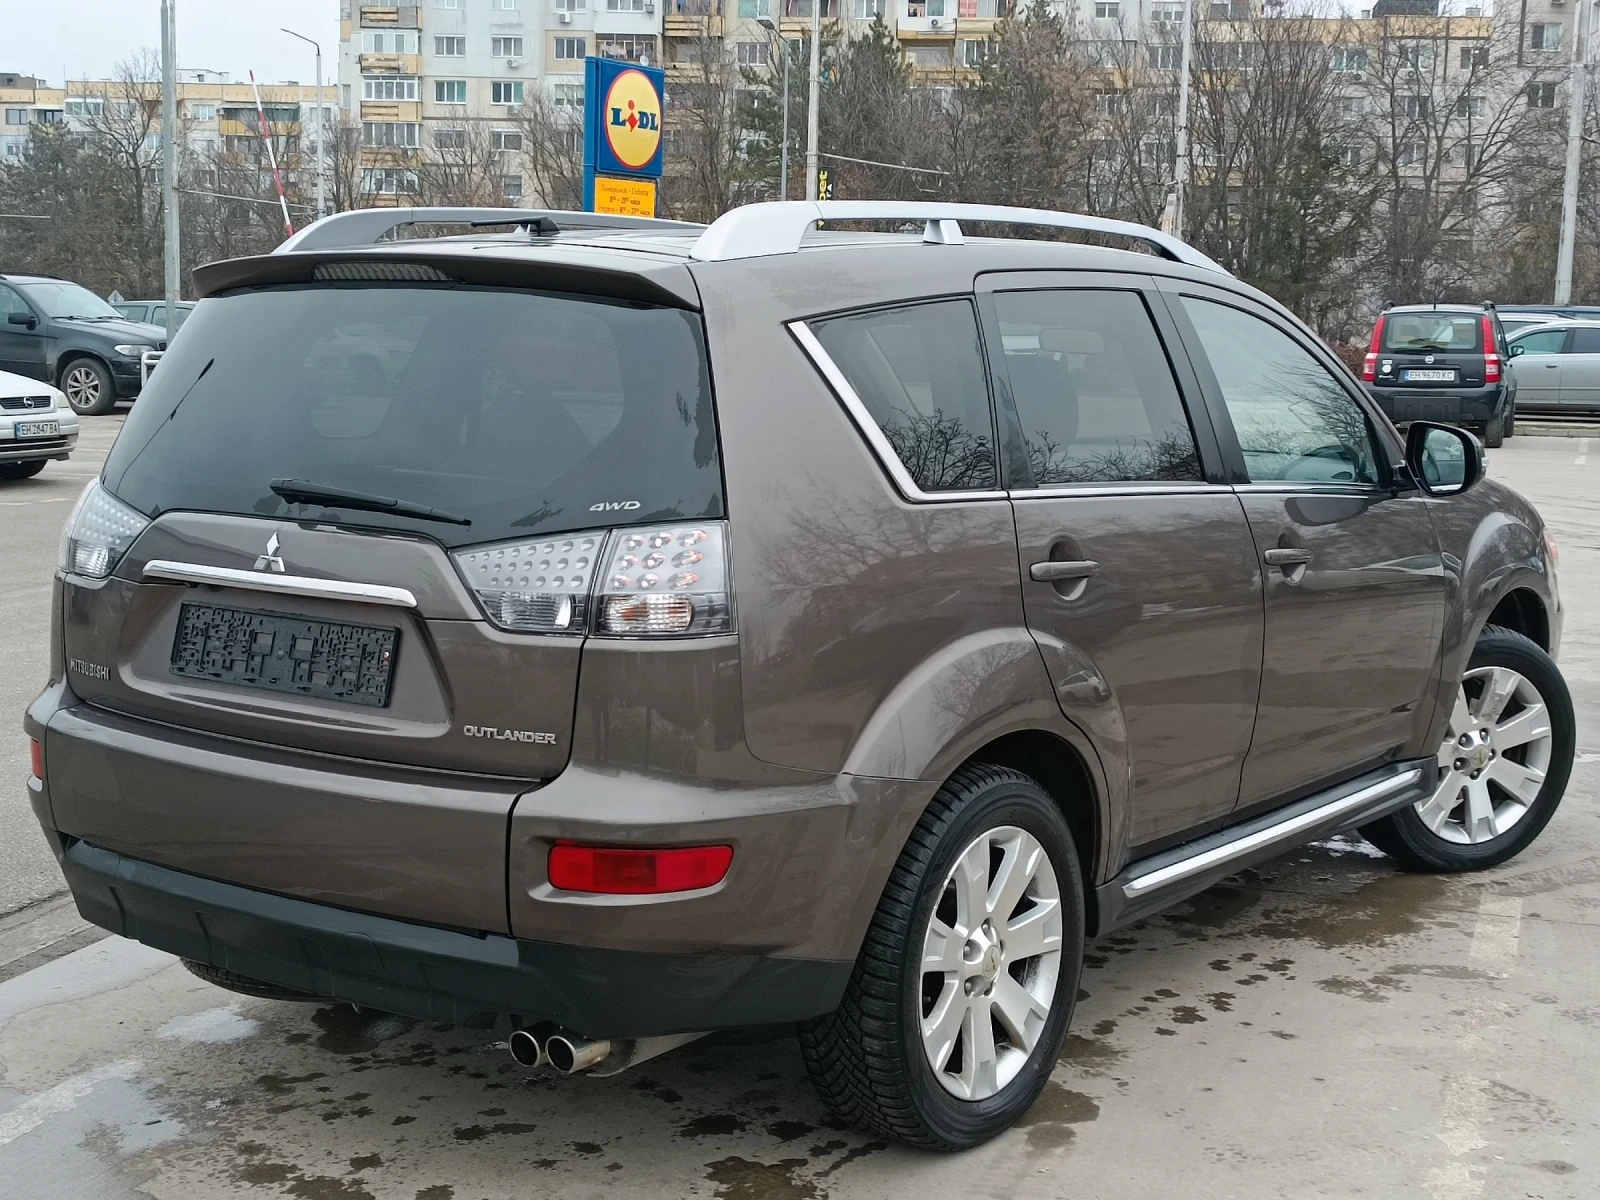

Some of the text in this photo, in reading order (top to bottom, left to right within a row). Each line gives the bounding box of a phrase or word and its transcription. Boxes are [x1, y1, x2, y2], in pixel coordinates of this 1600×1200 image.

[21, 425, 31, 435] EH
[589, 500, 641, 511] 4WD
[70, 657, 110, 681] MITSUBISHI
[463, 725, 556, 744] OUTLANDER
